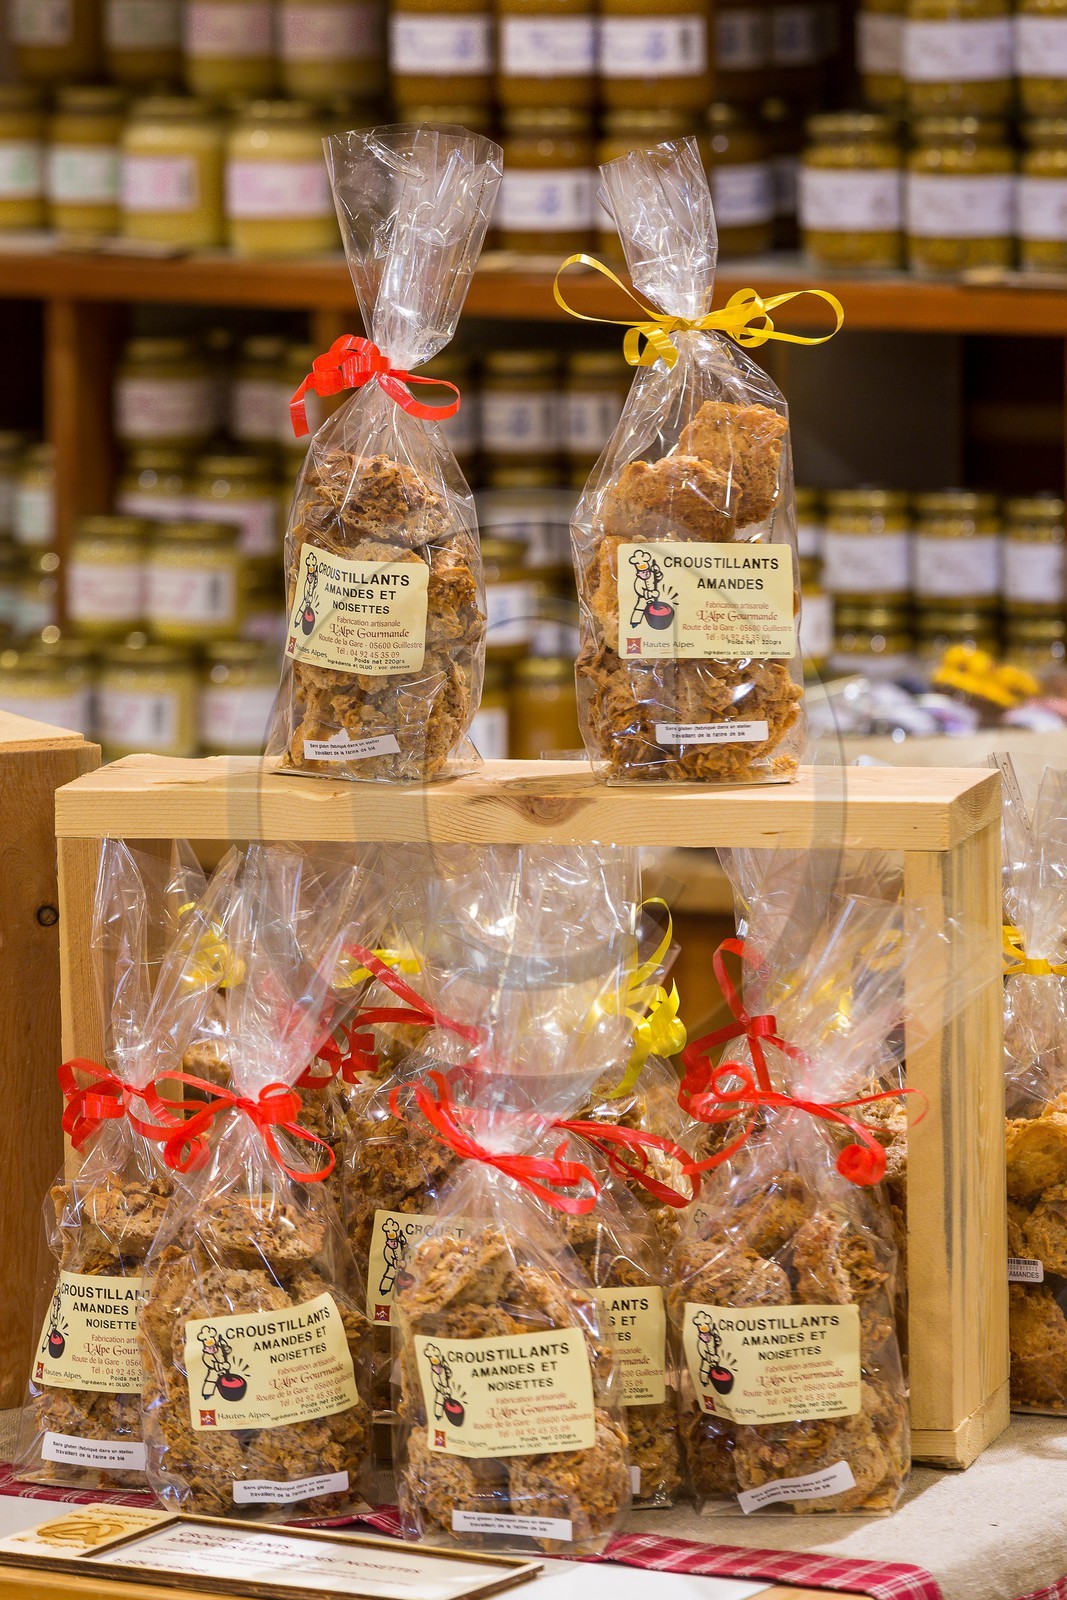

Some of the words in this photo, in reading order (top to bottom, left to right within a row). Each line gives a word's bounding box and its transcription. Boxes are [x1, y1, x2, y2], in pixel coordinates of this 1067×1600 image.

[663, 556, 779, 569] CROUSTILLANTS
[319, 562, 410, 586] CROUSTILLANTS
[697, 578, 763, 590] AMANDES
[325, 583, 374, 599] AMANDES
[380, 590, 396, 600] ET
[333, 601, 390, 614] NOISETTES
[705, 601, 738, 609] Fabrication
[337, 616, 369, 626] Fabrication
[696, 611, 726, 622] L'Alpe
[728, 611, 778, 621] Gourmande
[329, 623, 354, 637] L'Alpe
[357, 627, 409, 638] Gourmande
[319, 634, 333, 643] Route
[349, 640, 363, 648] Gare
[393, 641, 423, 649] Guillestre
[673, 640, 694, 649] Alpes
[311, 649, 327, 658] Alpes
[336, 647, 345, 655] Tél
[360, 650, 368, 658] 92
[61, 1283, 150, 1300] CROUSTILLANT
[73, 1302, 128, 1315] AMANDES
[86, 1319, 136, 1330] NOISETTE
[225, 1306, 330, 1340] CROUSTILLANTS
[622, 1316, 636, 1325] ET
[718, 1315, 840, 1331] CROUSTILLANTS
[92, 1334, 124, 1343] Fabrication
[253, 1331, 312, 1352] AMANDES
[316, 1325, 326, 1338] ET
[742, 1332, 804, 1346] AMANDES
[811, 1331, 827, 1341] ET
[84, 1343, 110, 1356] L'Alpe
[270, 1343, 327, 1364] NOISETTES
[447, 1342, 569, 1363] CROUSTILLANTS
[758, 1345, 822, 1361] NOISETTES
[72, 1355, 88, 1363] Route
[89, 1356, 96, 1364] de
[98, 1356, 102, 1364] la
[64, 1371, 81, 1379] Alpes
[301, 1363, 343, 1383] Gourmande
[471, 1363, 535, 1378] AMANDES
[542, 1361, 558, 1372] ET
[488, 1378, 554, 1392] NOISETTES
[256, 1394, 275, 1402] Route
[218, 1412, 246, 1420] Hautes
[248, 1412, 271, 1420] Alpes
